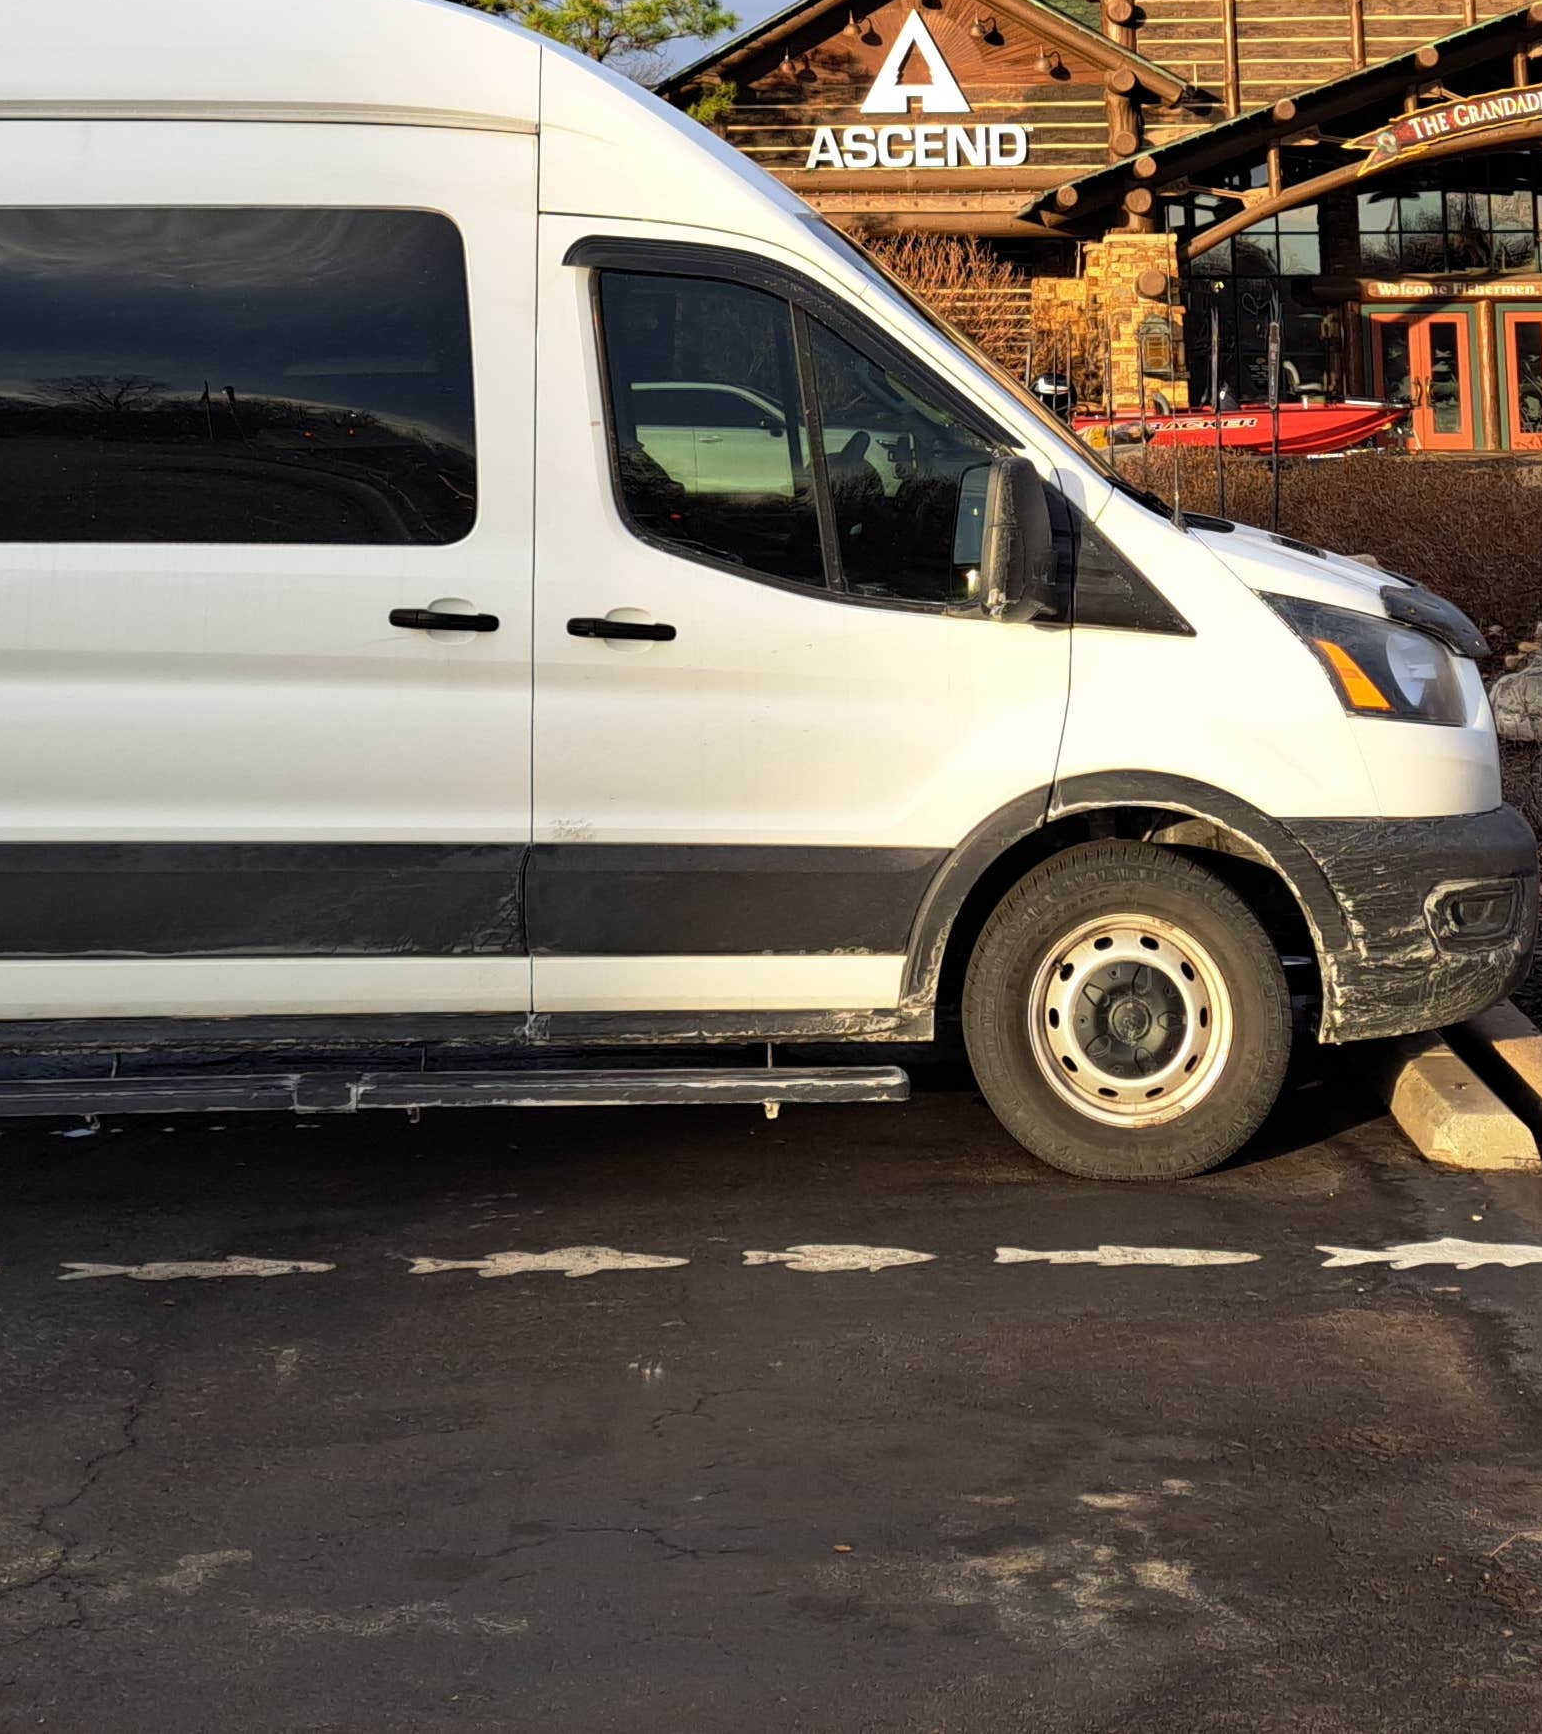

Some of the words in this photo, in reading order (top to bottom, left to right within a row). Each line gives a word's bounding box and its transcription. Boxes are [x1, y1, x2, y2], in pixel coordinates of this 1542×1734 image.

[1409, 112, 1450, 139] THE
[806, 124, 1028, 168] ASCEND
[1376, 282, 1448, 296] Welcome
